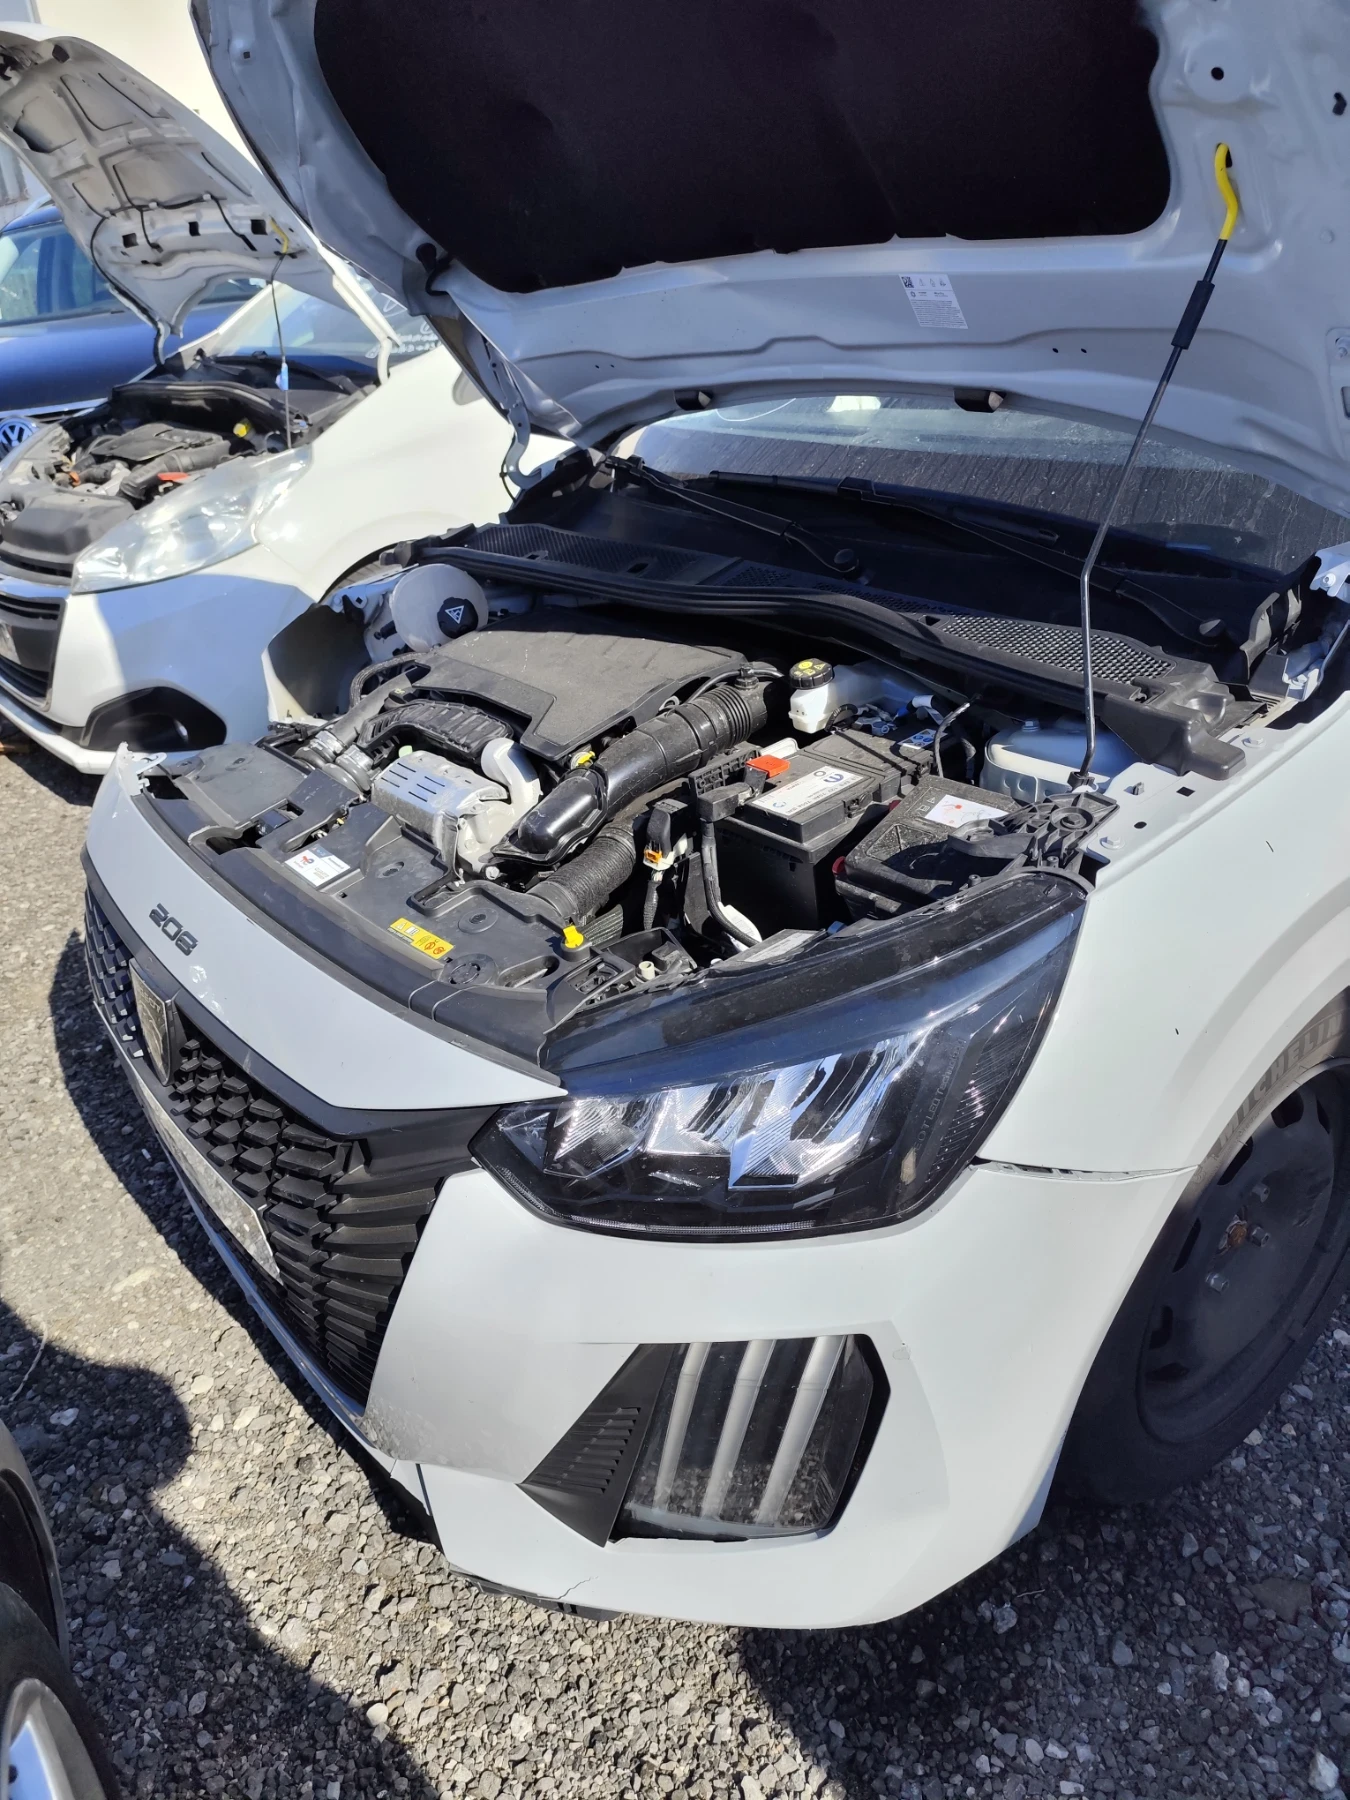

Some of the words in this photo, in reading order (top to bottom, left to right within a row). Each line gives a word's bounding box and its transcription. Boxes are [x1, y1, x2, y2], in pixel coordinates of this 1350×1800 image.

[149, 903, 198, 956] 208
[1218, 1012, 1343, 1147] MICHELIN
[926, 1098, 941, 1120] LED
